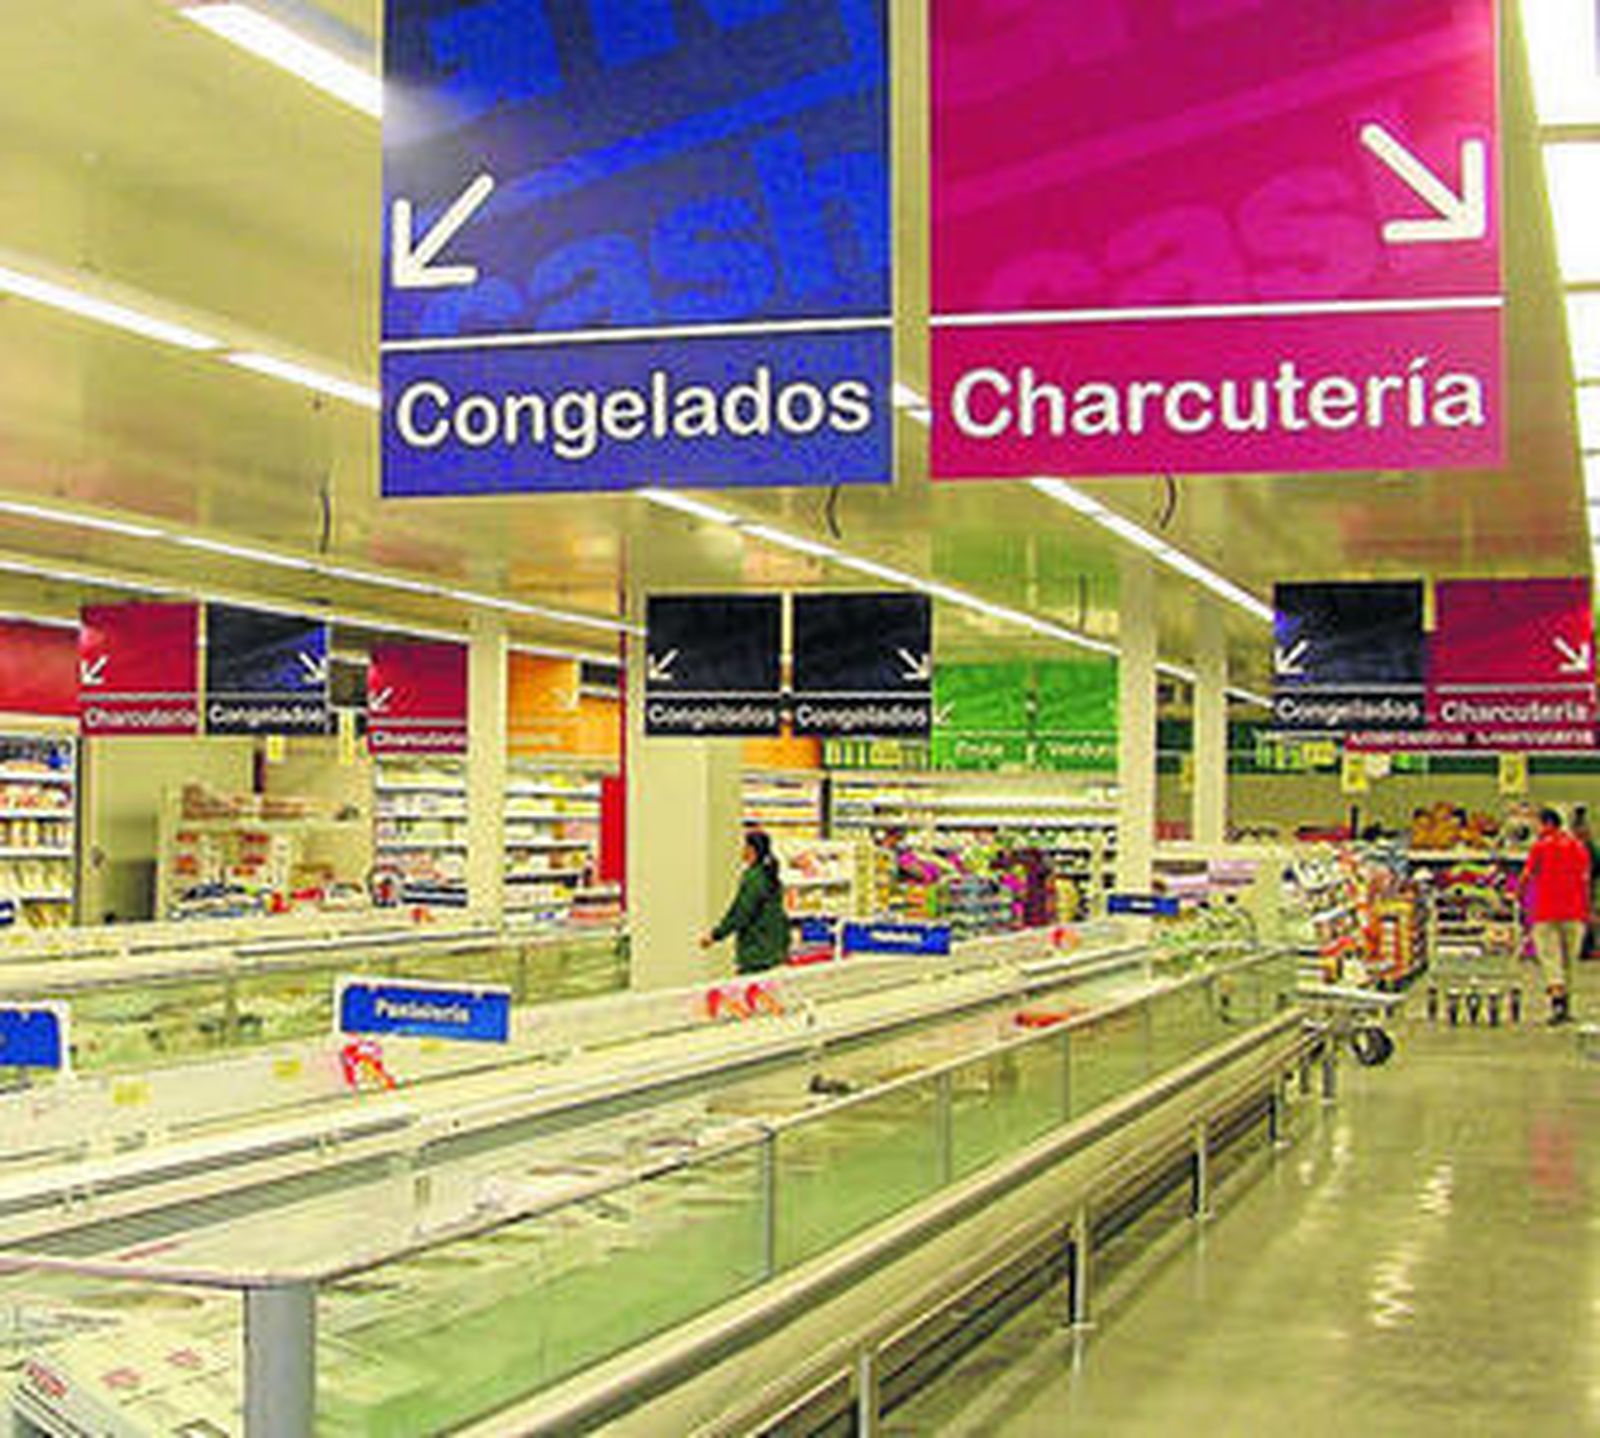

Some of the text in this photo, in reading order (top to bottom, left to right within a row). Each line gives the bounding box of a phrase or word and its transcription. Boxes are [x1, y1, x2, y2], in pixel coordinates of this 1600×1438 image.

[949, 357, 1486, 438] Charcutería
[395, 366, 873, 459] Congelados
[648, 704, 775, 729] Congelados
[796, 703, 928, 729] Congelados
[1276, 697, 1419, 724] Congelados
